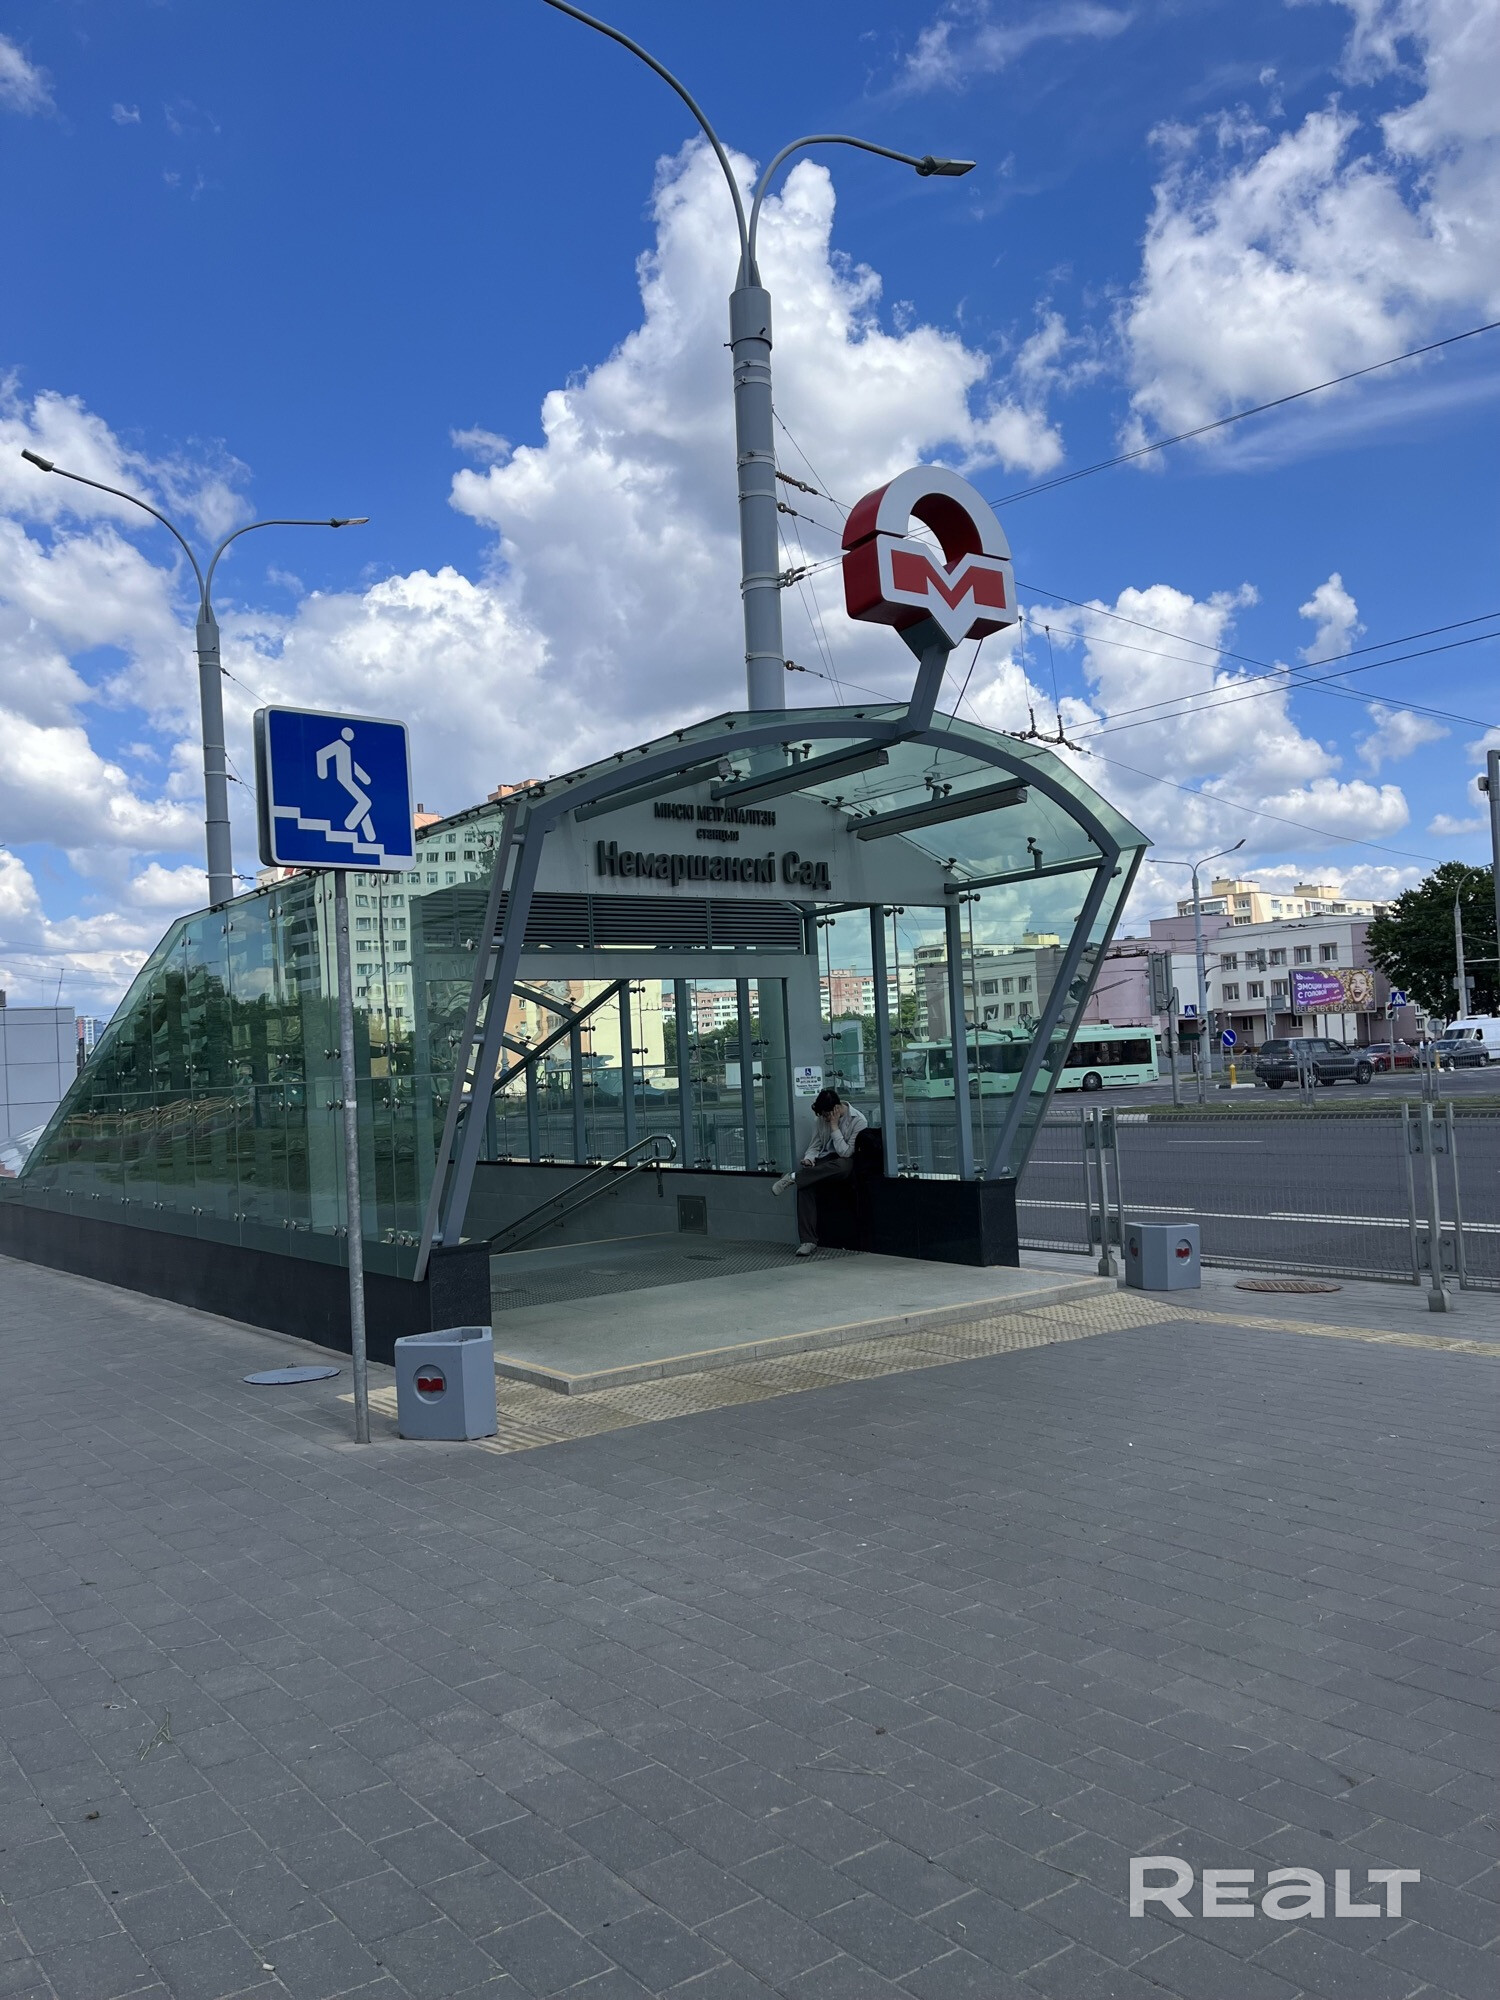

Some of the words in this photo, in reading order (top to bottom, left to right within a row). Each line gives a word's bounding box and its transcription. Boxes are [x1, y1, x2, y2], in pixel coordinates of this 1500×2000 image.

[654, 801, 694, 821] МІНСКІ
[696, 804, 776, 826] МЕТРАПАЛІТЭН
[696, 827, 739, 842] станцыя
[597, 840, 776, 887] Немаршанскі
[782, 851, 832, 890] Сад
